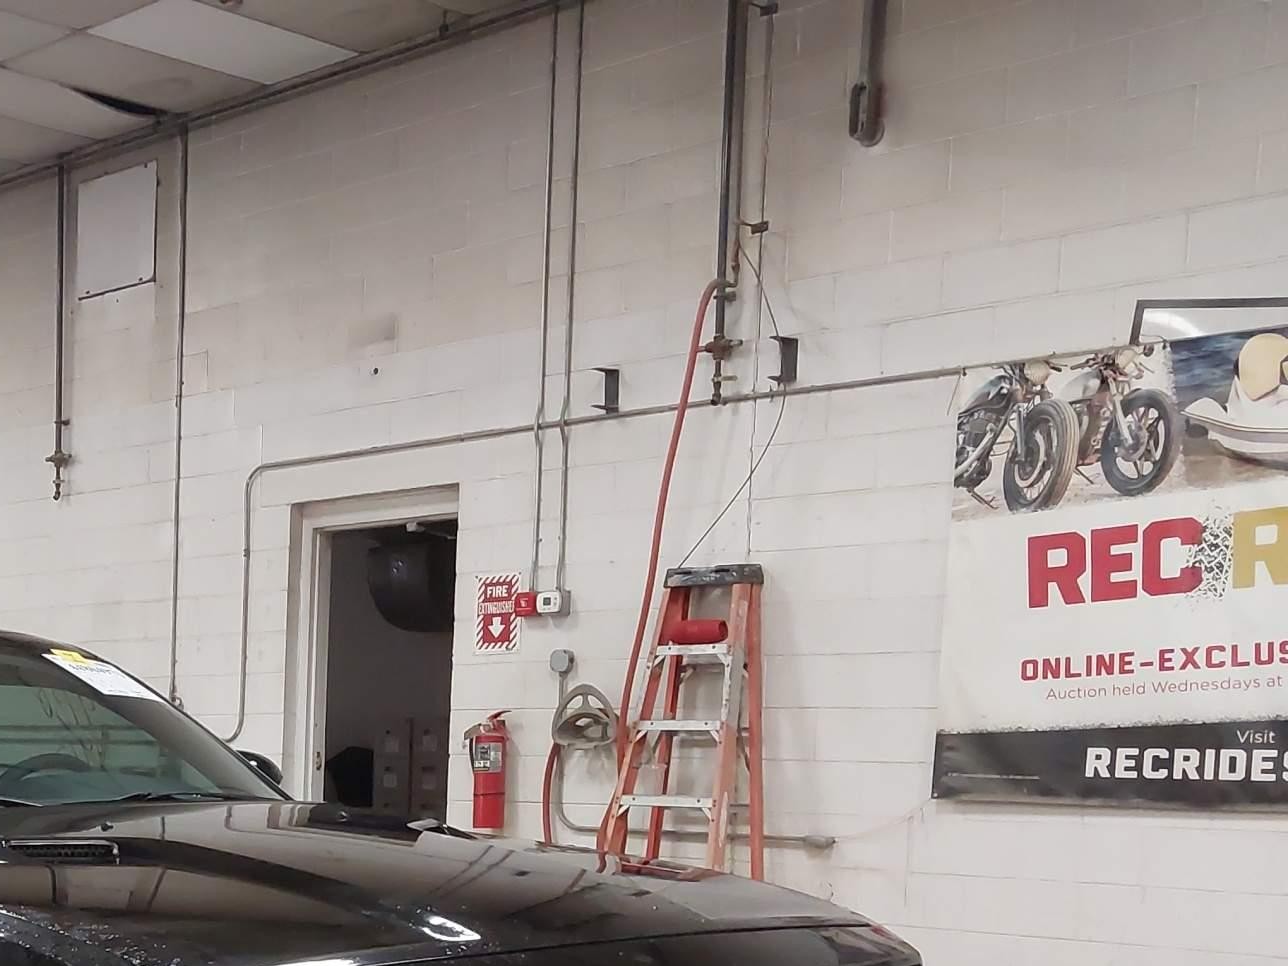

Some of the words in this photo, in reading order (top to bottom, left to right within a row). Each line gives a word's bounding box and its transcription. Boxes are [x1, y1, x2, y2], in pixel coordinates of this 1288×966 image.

[1027, 517, 1204, 608] REC
[486, 585, 509, 598] FIRE
[1046, 686, 1108, 700] Auction
[1112, 682, 1146, 697] held
[1151, 676, 1261, 694] Wednesdays
[1266, 675, 1283, 688] at
[1236, 729, 1276, 744] Visit
[1085, 747, 1288, 782] RECRIDE
